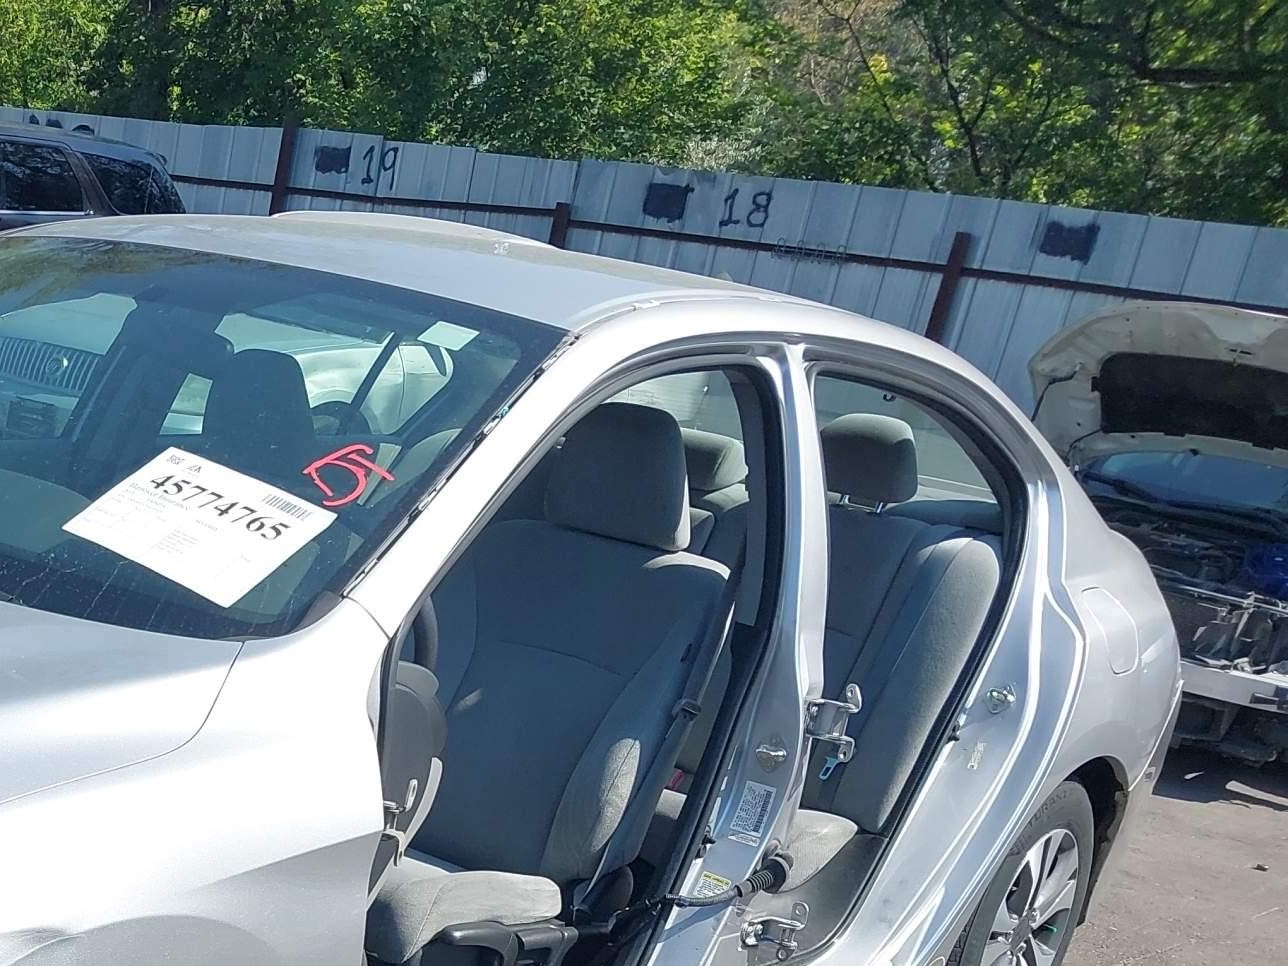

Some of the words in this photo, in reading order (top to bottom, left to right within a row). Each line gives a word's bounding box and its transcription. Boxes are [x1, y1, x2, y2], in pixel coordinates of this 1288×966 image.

[361, 145, 399, 192] 19
[719, 188, 773, 227] 18
[150, 475, 292, 541] 45774765
